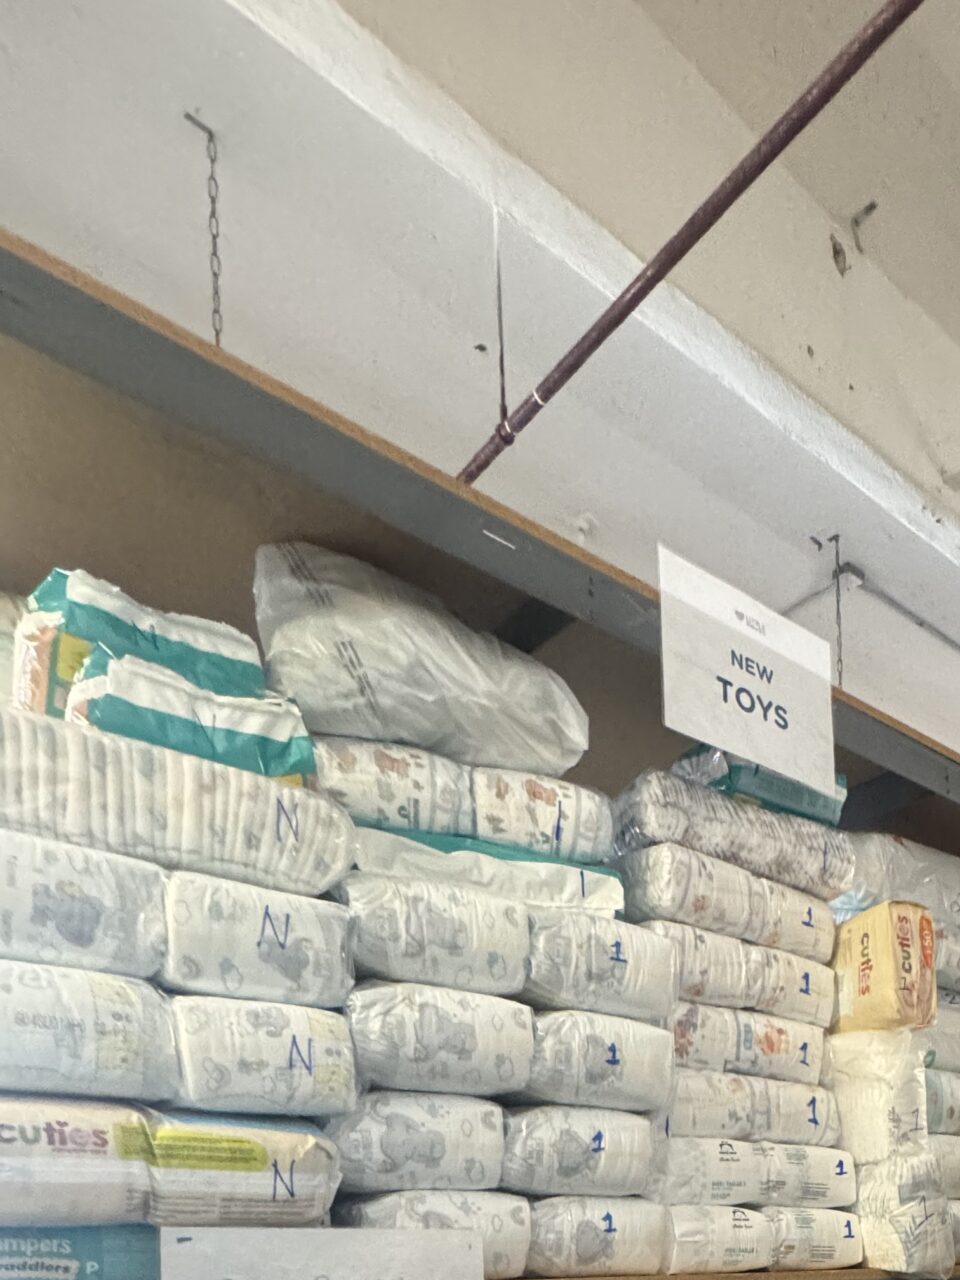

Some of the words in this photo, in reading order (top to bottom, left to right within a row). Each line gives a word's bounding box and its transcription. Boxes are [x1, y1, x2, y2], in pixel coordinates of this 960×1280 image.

[730, 649, 773, 684] NEW
[716, 675, 789, 730] TOYS
[276, 796, 298, 842] N
[257, 905, 290, 950] N
[802, 907, 814, 928] 1
[609, 940, 628, 963] 1
[897, 914, 912, 974] cuties
[860, 932, 874, 997] cuties
[801, 972, 811, 996] 1
[288, 1034, 313, 1077] N
[605, 1043, 620, 1065] 1
[800, 1042, 810, 1067] 1
[808, 1096, 820, 1127] 1
[0, 1120, 110, 1149] cuties
[591, 1130, 605, 1153] 1
[272, 1159, 296, 1200] N
[835, 1159, 848, 1175] 1
[601, 1211, 617, 1233] 1
[843, 1220, 855, 1239] 1
